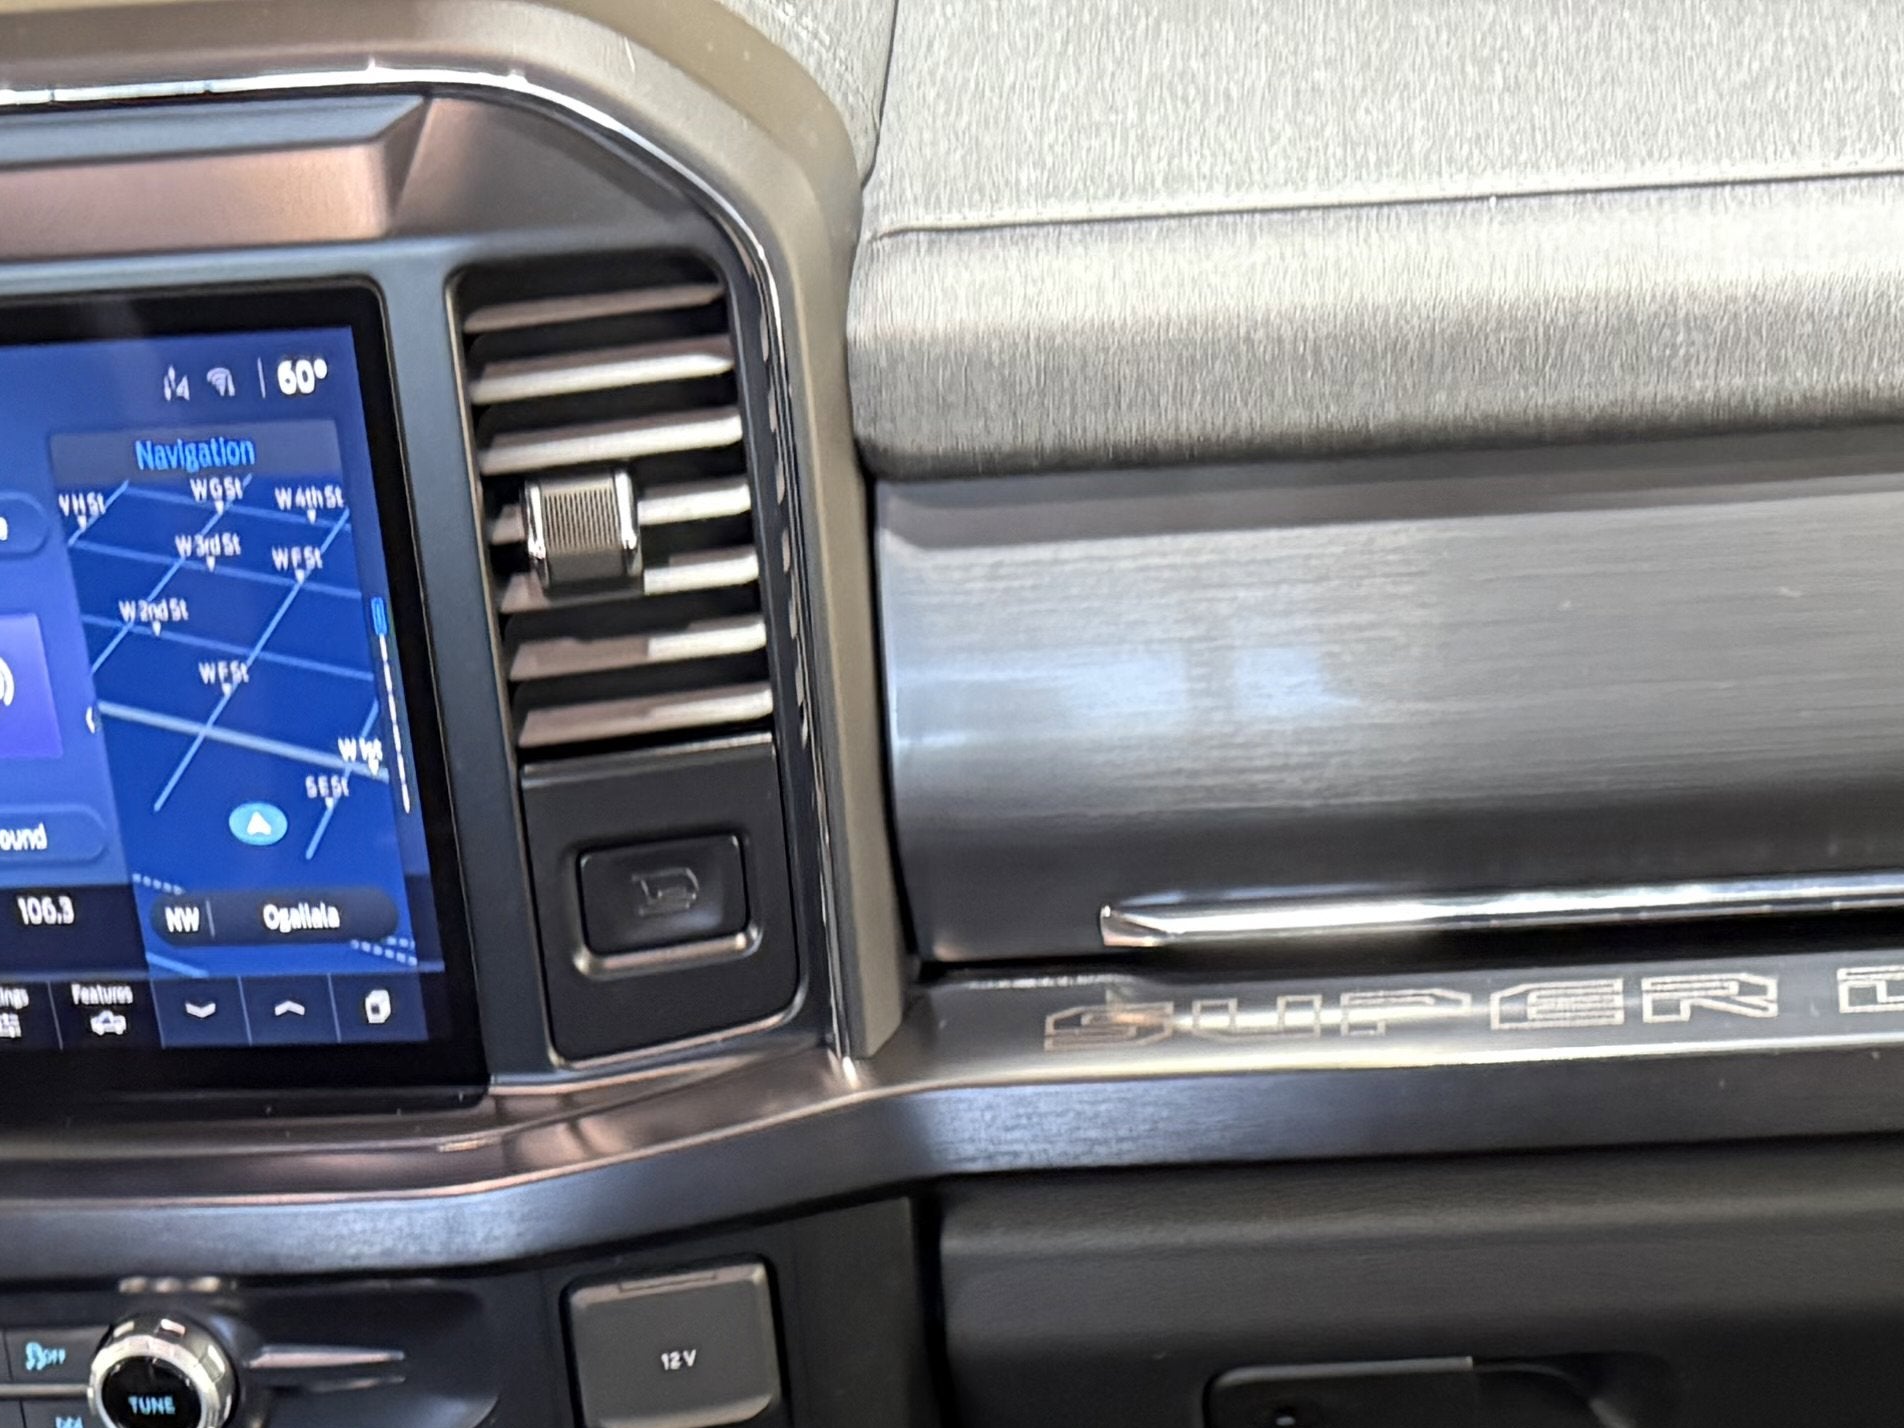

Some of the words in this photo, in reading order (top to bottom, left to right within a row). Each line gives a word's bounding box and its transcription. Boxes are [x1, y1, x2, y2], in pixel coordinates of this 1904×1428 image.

[276, 358, 329, 395] 60°
[135, 438, 257, 472] Navigation
[165, 905, 201, 934] NW
[71, 982, 134, 1007] Features
[127, 1396, 177, 1416] TUNE
